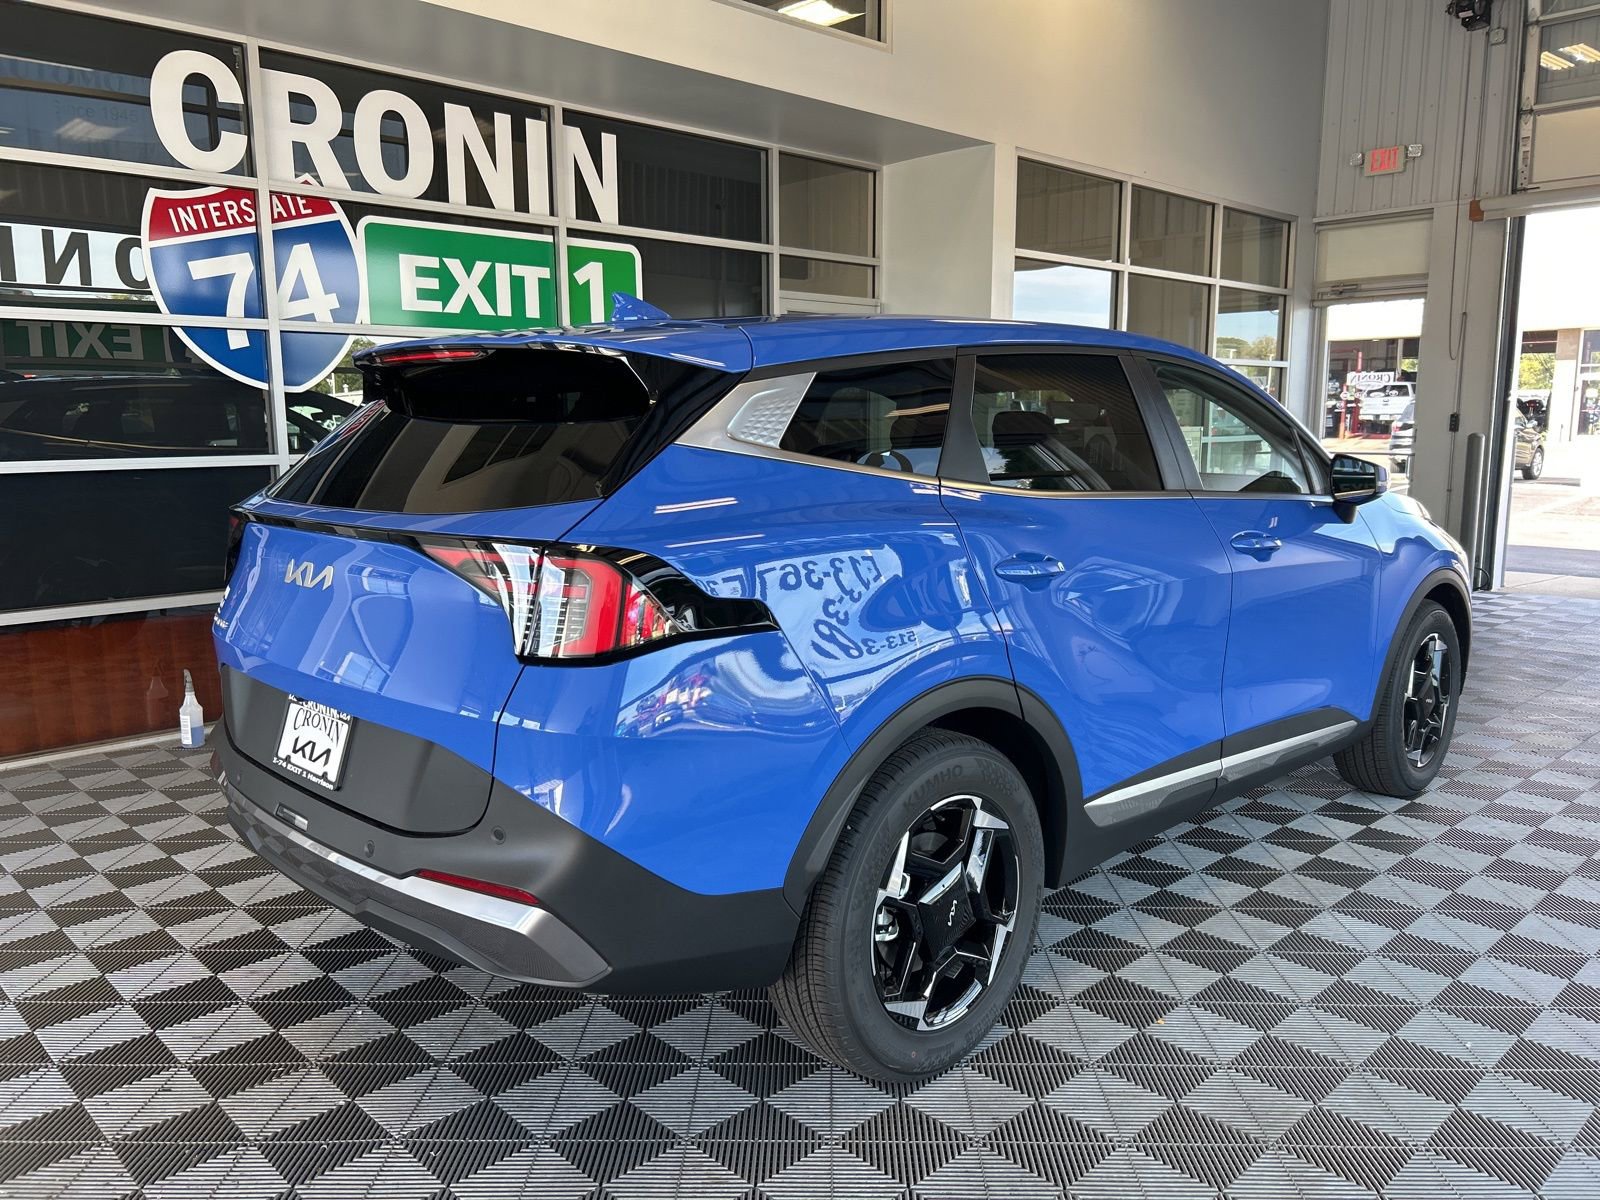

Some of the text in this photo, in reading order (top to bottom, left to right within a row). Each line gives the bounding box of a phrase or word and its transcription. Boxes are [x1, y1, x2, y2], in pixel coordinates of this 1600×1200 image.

[150, 49, 619, 226] CRONIN
[1370, 145, 1400, 173] EXIT
[167, 191, 314, 234] INTERSATE
[187, 243, 341, 351] 74
[398, 253, 604, 323] EXIT 1
[285, 558, 335, 591] KIA
[293, 707, 344, 748] CRONIN
[292, 735, 332, 768] KIA
[286, 763, 302, 775] EXIT
[307, 772, 334, 790] Harrison
